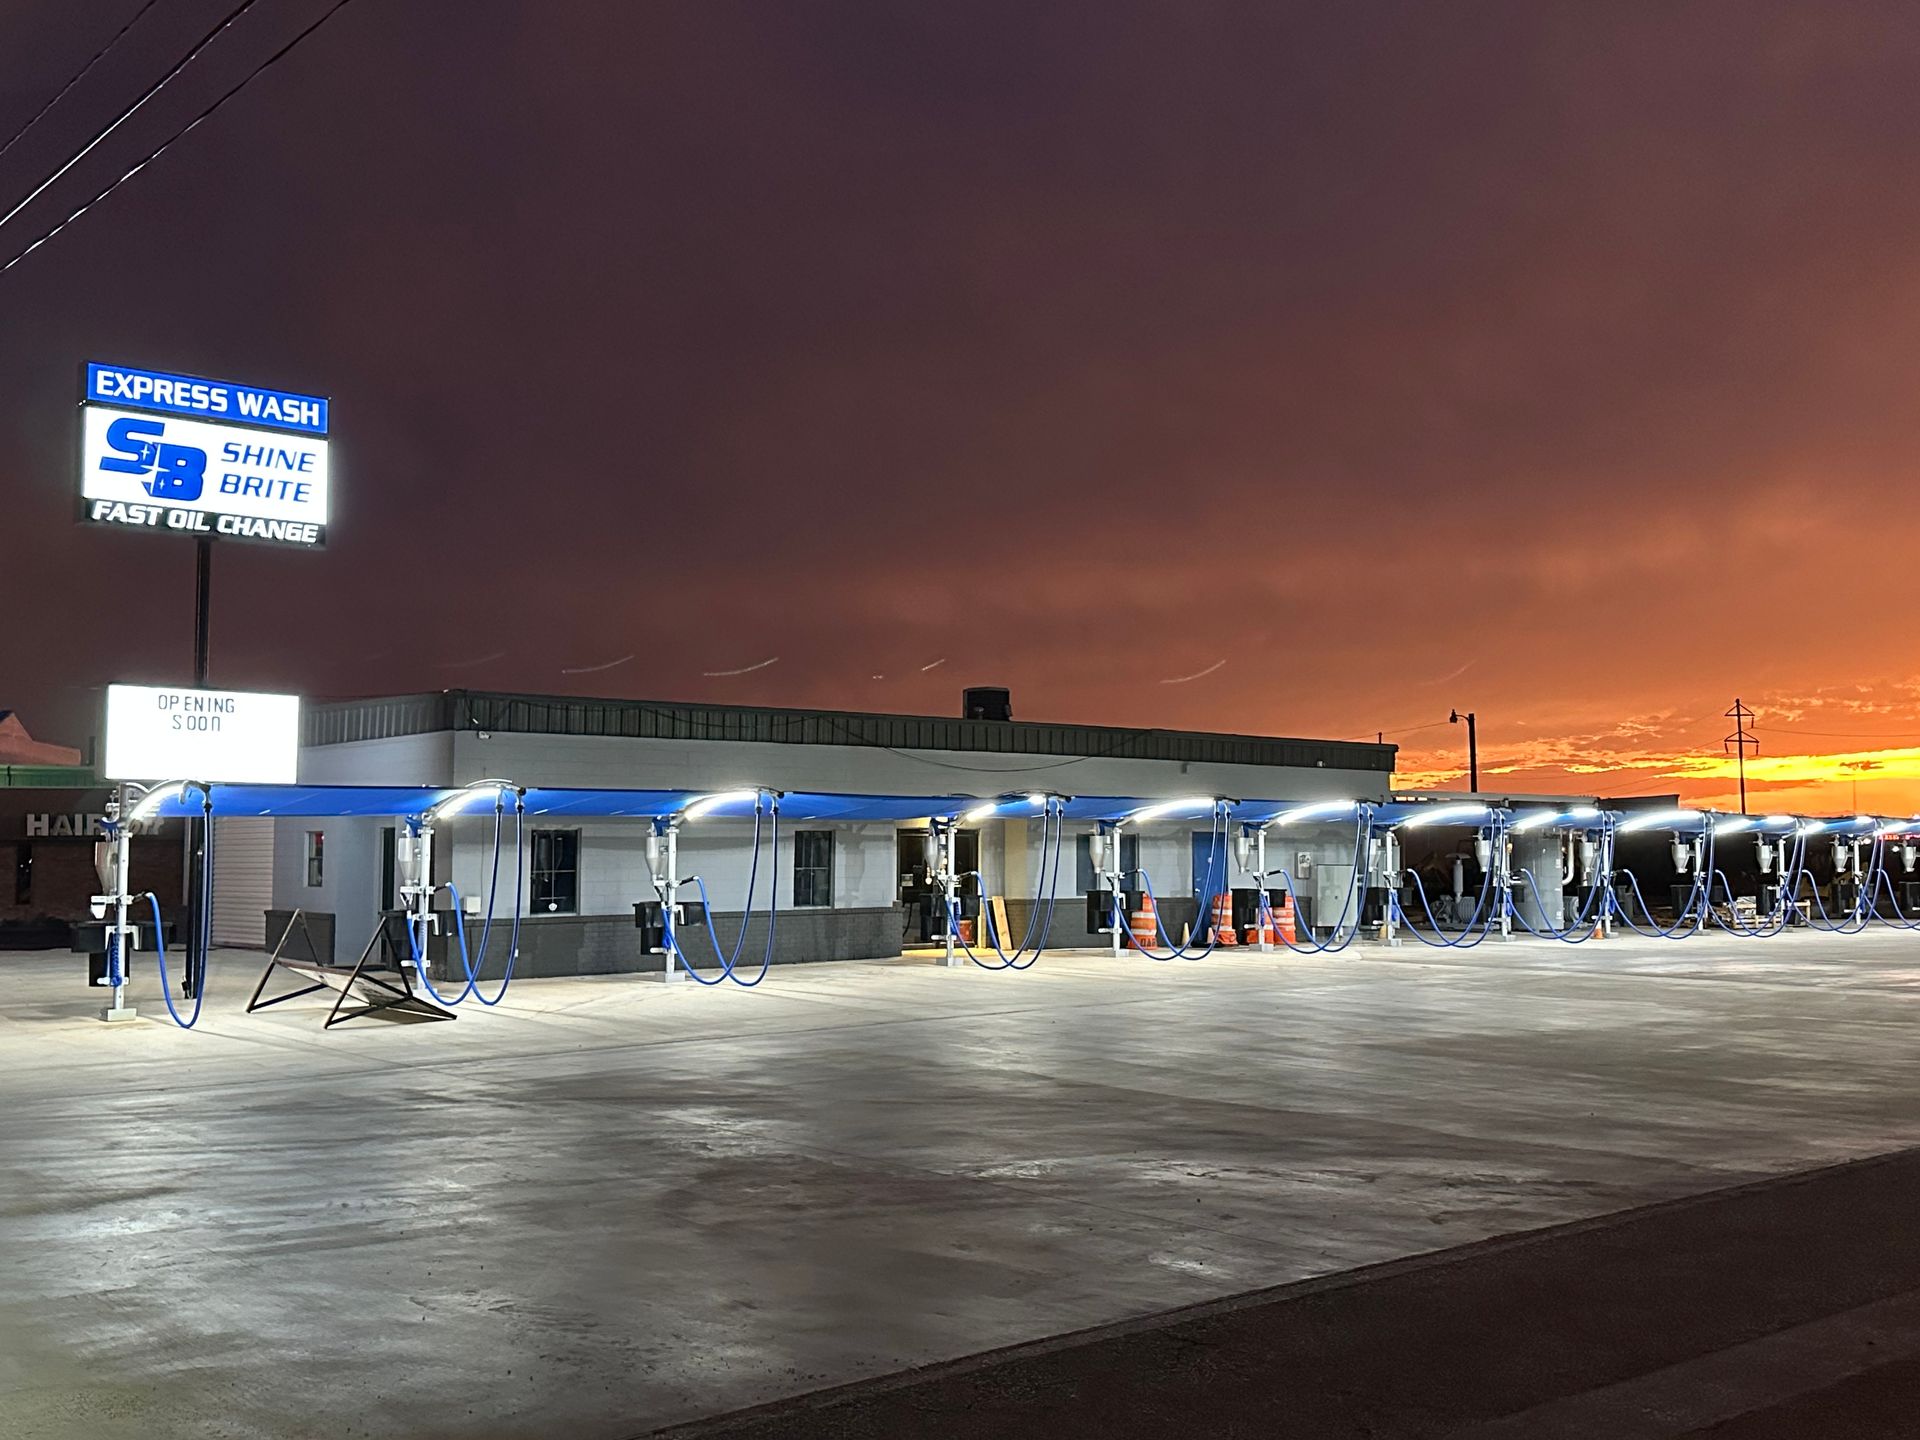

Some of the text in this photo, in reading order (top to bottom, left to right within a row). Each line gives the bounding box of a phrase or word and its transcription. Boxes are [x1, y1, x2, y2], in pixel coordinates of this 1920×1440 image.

[96, 370, 320, 426] EXPRESS WASH
[221, 442, 317, 473] SHINE
[219, 473, 313, 503] BRITE
[92, 501, 319, 543] FAST OIL CHANGE
[158, 694, 235, 713] OPENING
